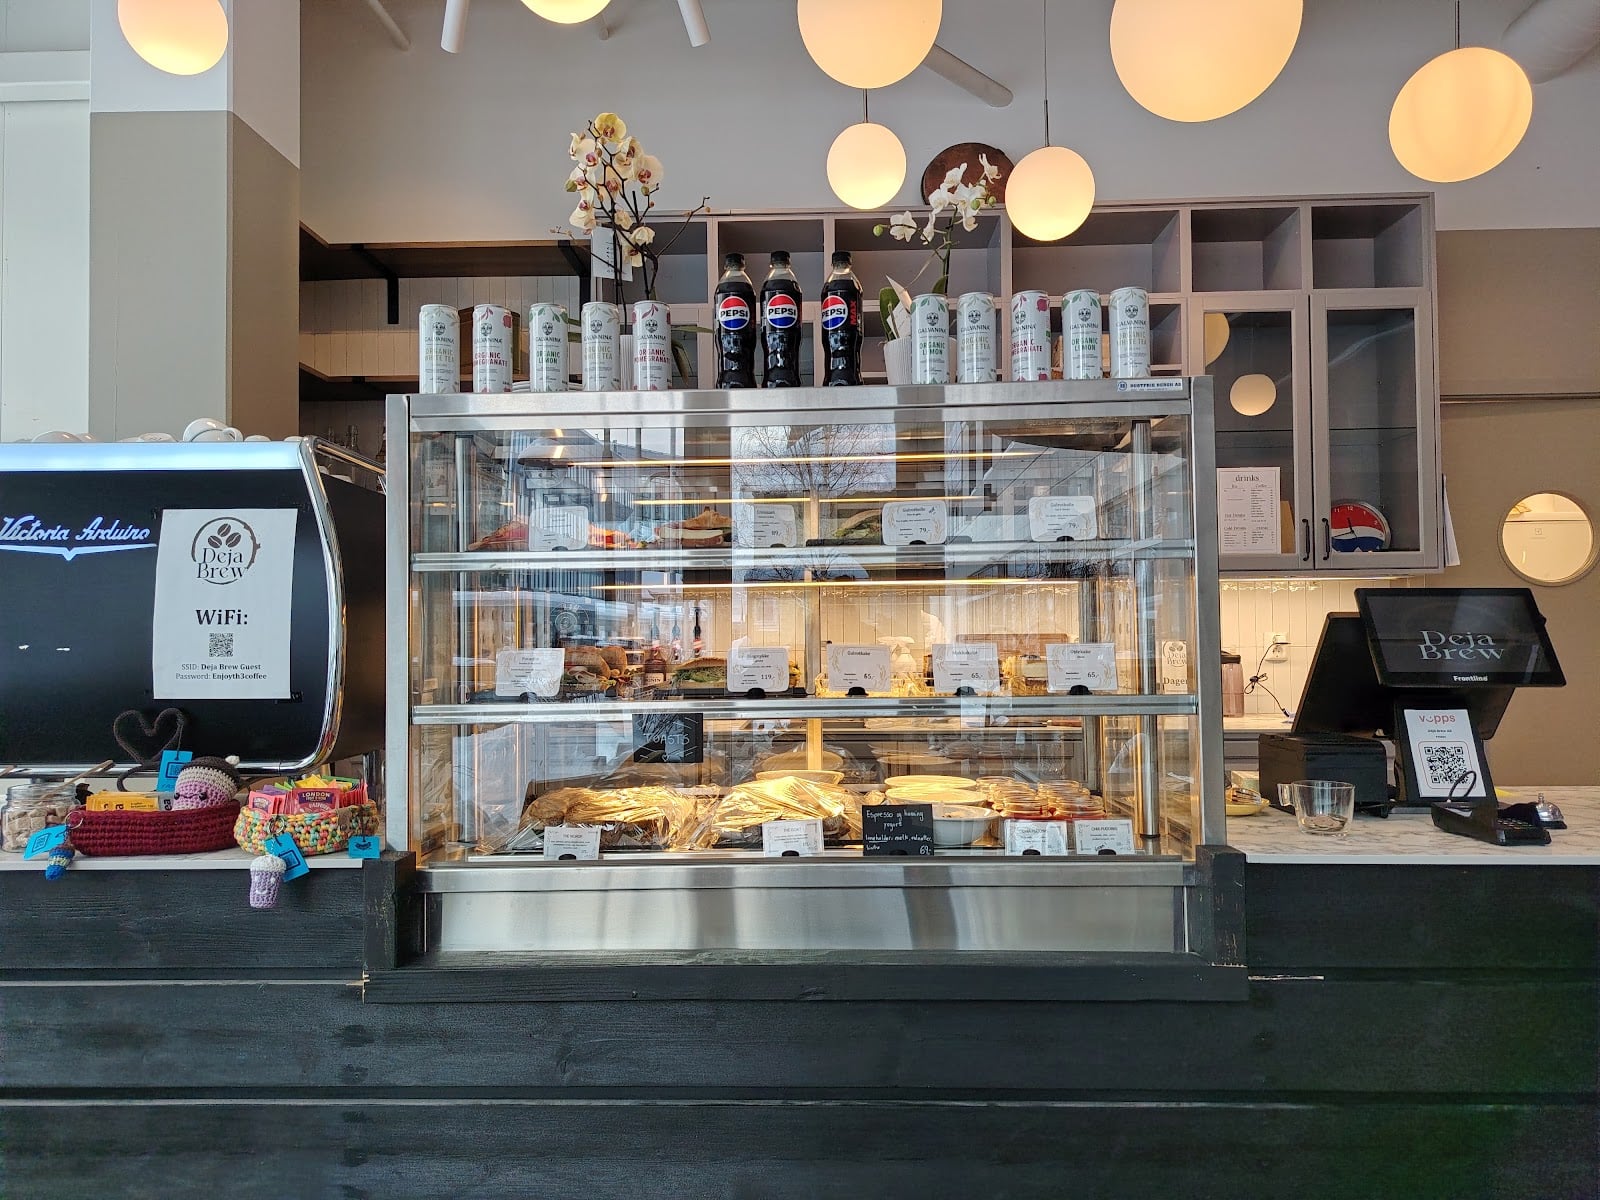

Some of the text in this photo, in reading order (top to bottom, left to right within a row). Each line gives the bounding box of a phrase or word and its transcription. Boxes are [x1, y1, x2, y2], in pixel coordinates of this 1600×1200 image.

[720, 309, 748, 318] PEPSI
[768, 307, 796, 317] PEPSI
[821, 309, 846, 318] PEPSI
[849, 301, 857, 326] MAX
[919, 341, 945, 350] ORGANIC
[1072, 337, 1098, 345] ORGANIC
[1074, 344, 1096, 352] LEMON
[474, 359, 508, 367] OMEGRANATE
[0, 515, 150, 541] Victoria Arduino
[202, 547, 243, 567] Deja
[196, 562, 248, 579] Brew
[195, 609, 249, 625] WiFi:
[1419, 630, 1496, 649] Deja
[1417, 644, 1505, 660] Brew
[201, 663, 218, 672] Deja
[212, 672, 268, 681] Enjoyth3coffee
[643, 732, 690, 745] TOASTS
[866, 810, 894, 822] Espresso
